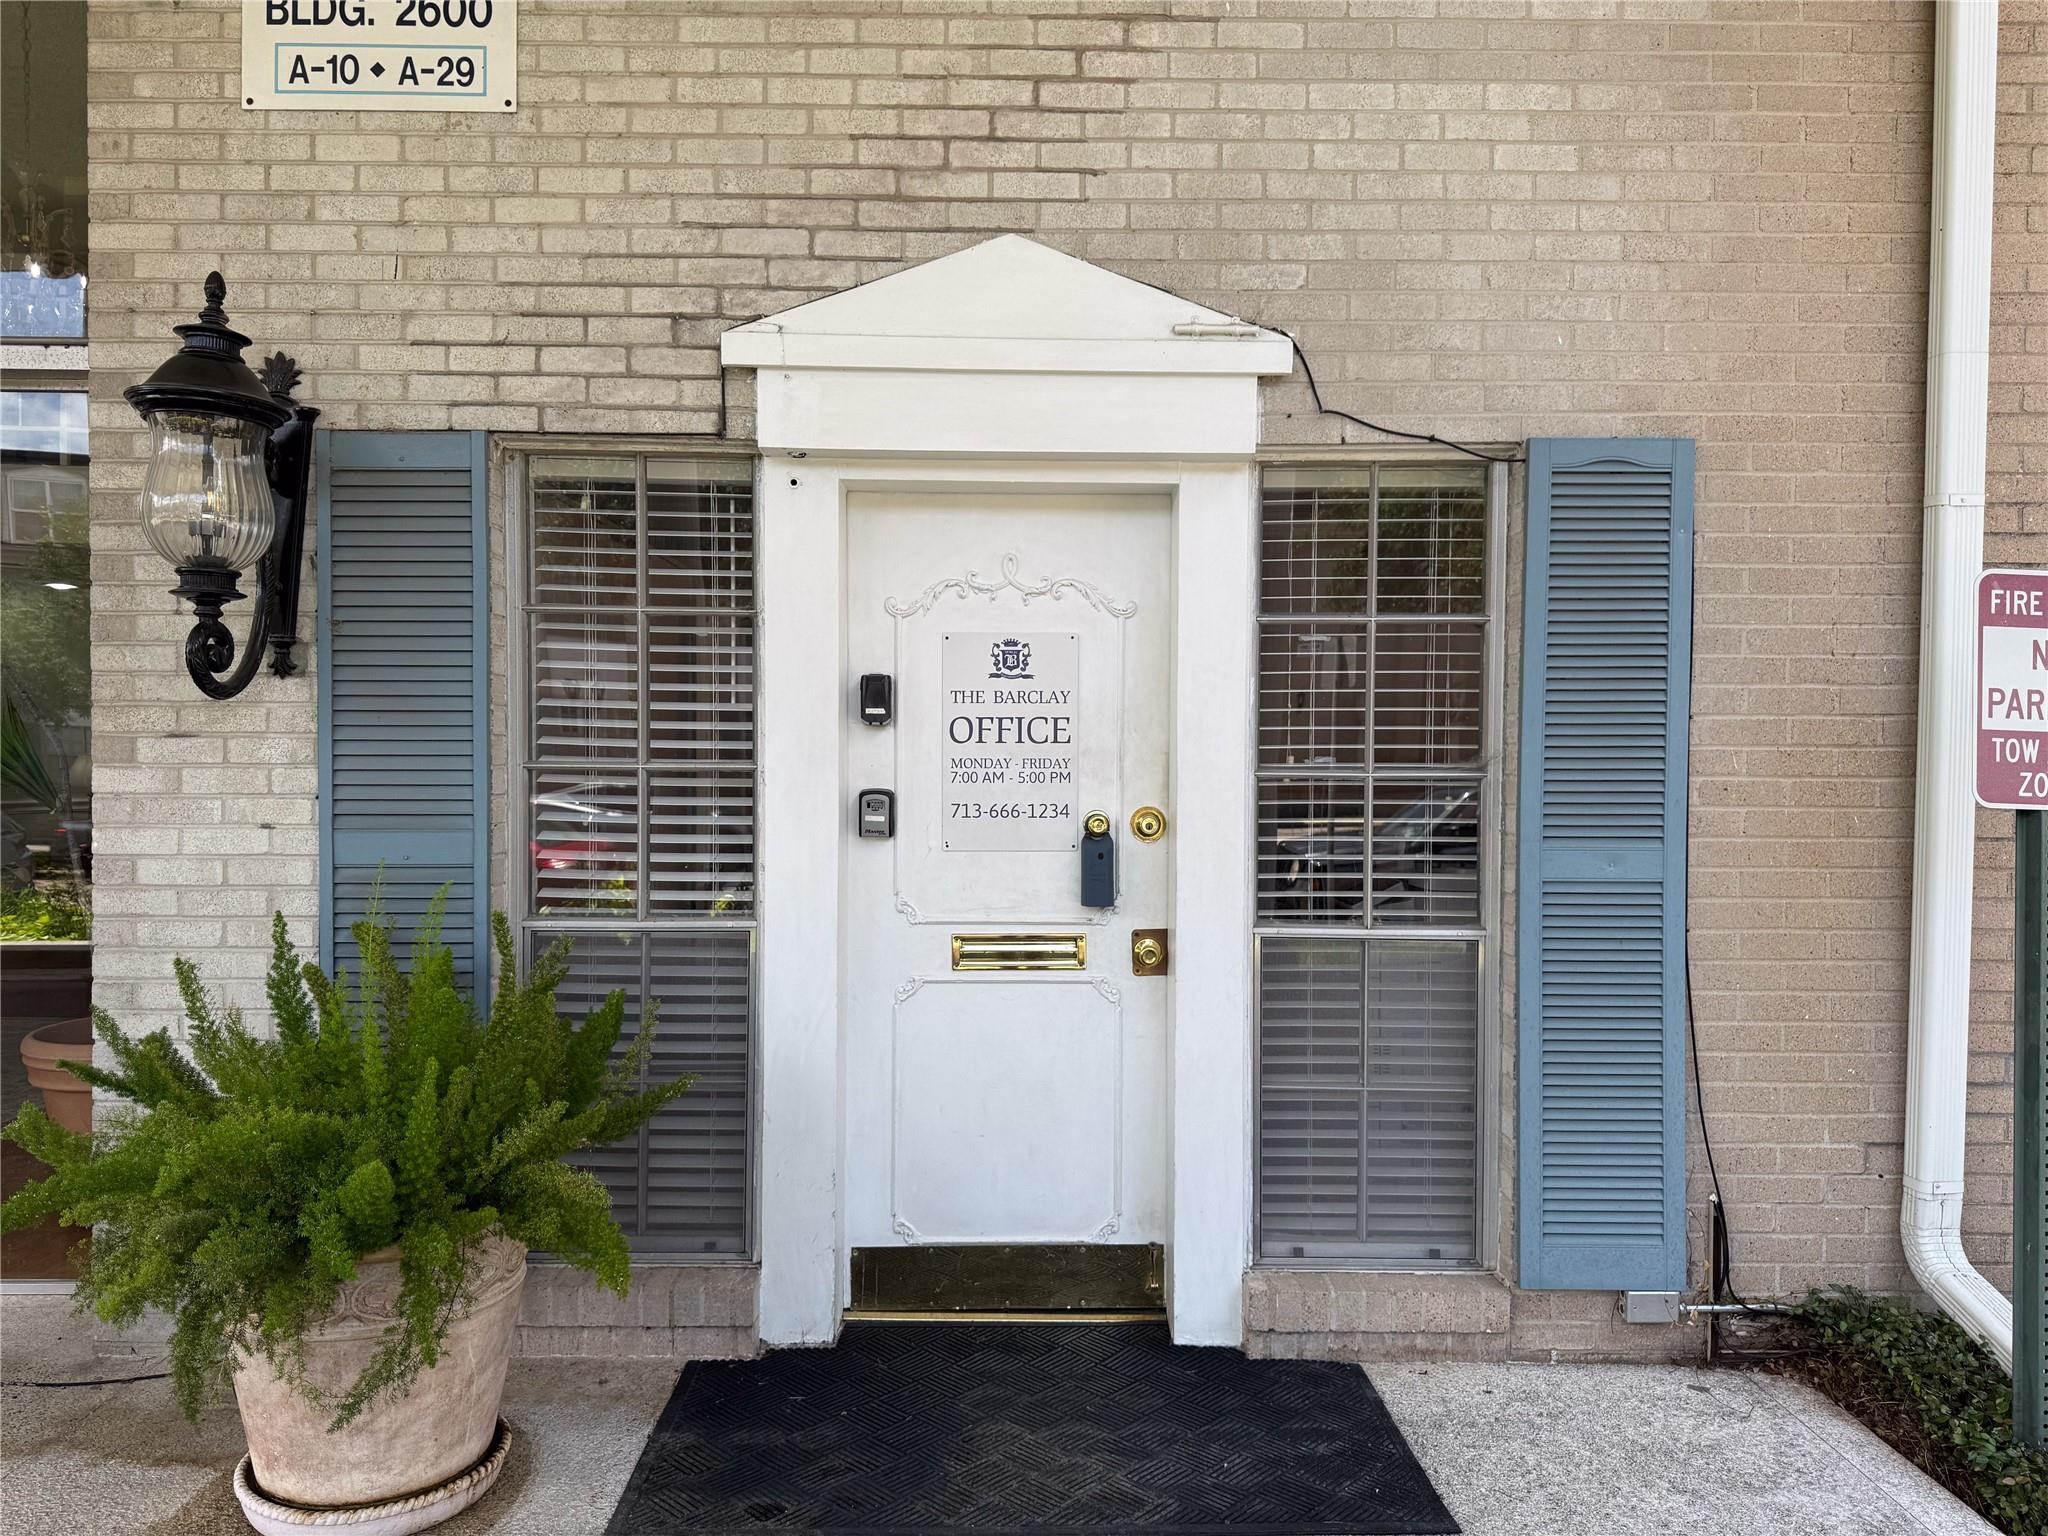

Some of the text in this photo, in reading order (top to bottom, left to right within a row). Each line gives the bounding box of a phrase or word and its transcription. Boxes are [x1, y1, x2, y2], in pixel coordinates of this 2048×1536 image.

[265, 0, 493, 28] BLDG. 2600
[288, 53, 475, 87] A-10 A-29
[1990, 589, 2044, 616] FIRE
[950, 690, 1071, 705] THE BARCLAY
[1987, 687, 2048, 720] PAR
[949, 716, 1071, 745] OFFICE
[950, 757, 1012, 769] MONDAY
[1022, 757, 1071, 769] FRIDAY
[1991, 737, 2040, 764] TOW
[950, 771, 979, 784] 7:00
[981, 771, 1005, 784] AM
[1018, 771, 1046, 784] 5:00
[1050, 771, 1071, 784] PM
[951, 803, 1070, 819] 713-666-1234
